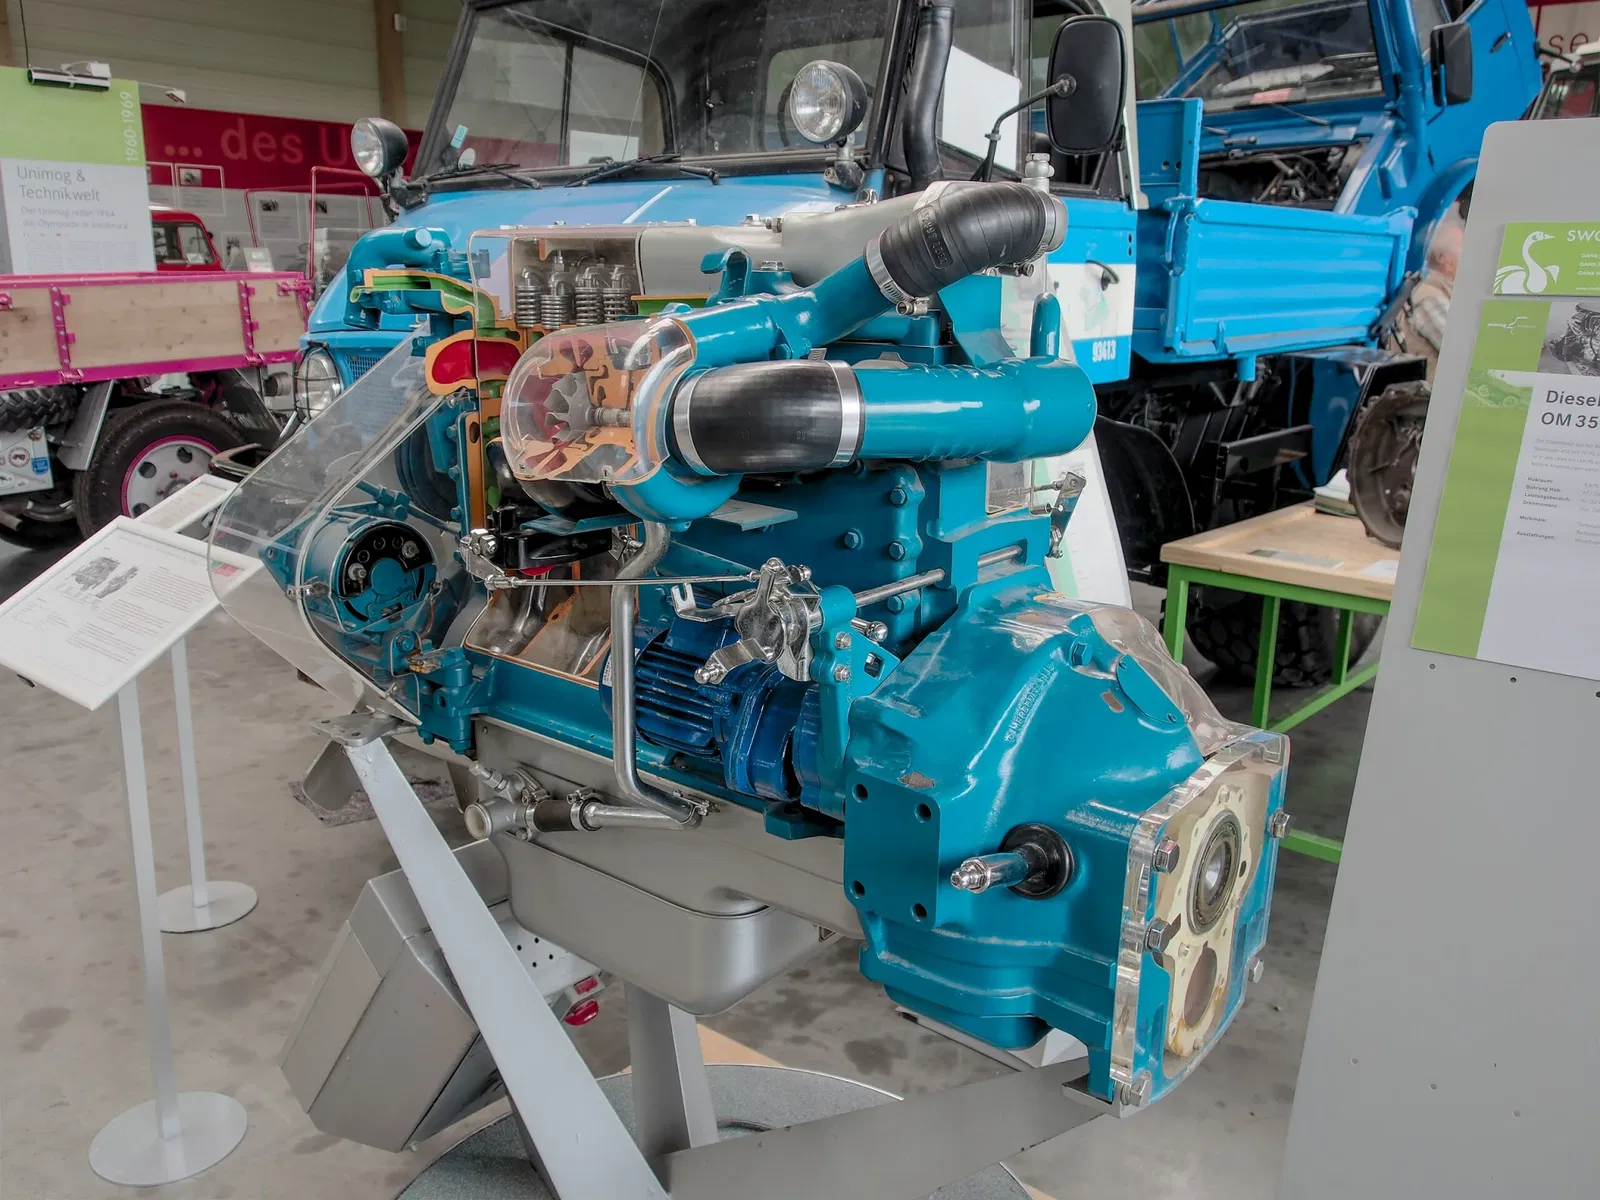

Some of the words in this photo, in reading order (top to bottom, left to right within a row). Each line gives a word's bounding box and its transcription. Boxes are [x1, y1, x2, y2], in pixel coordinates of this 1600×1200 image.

[120, 91, 139, 162] 1960-1969
[221, 118, 303, 164] des
[17, 166, 71, 185] Unimog
[76, 169, 85, 182] &
[19, 185, 100, 202] Technikwelt
[1541, 412, 1572, 426] OM
